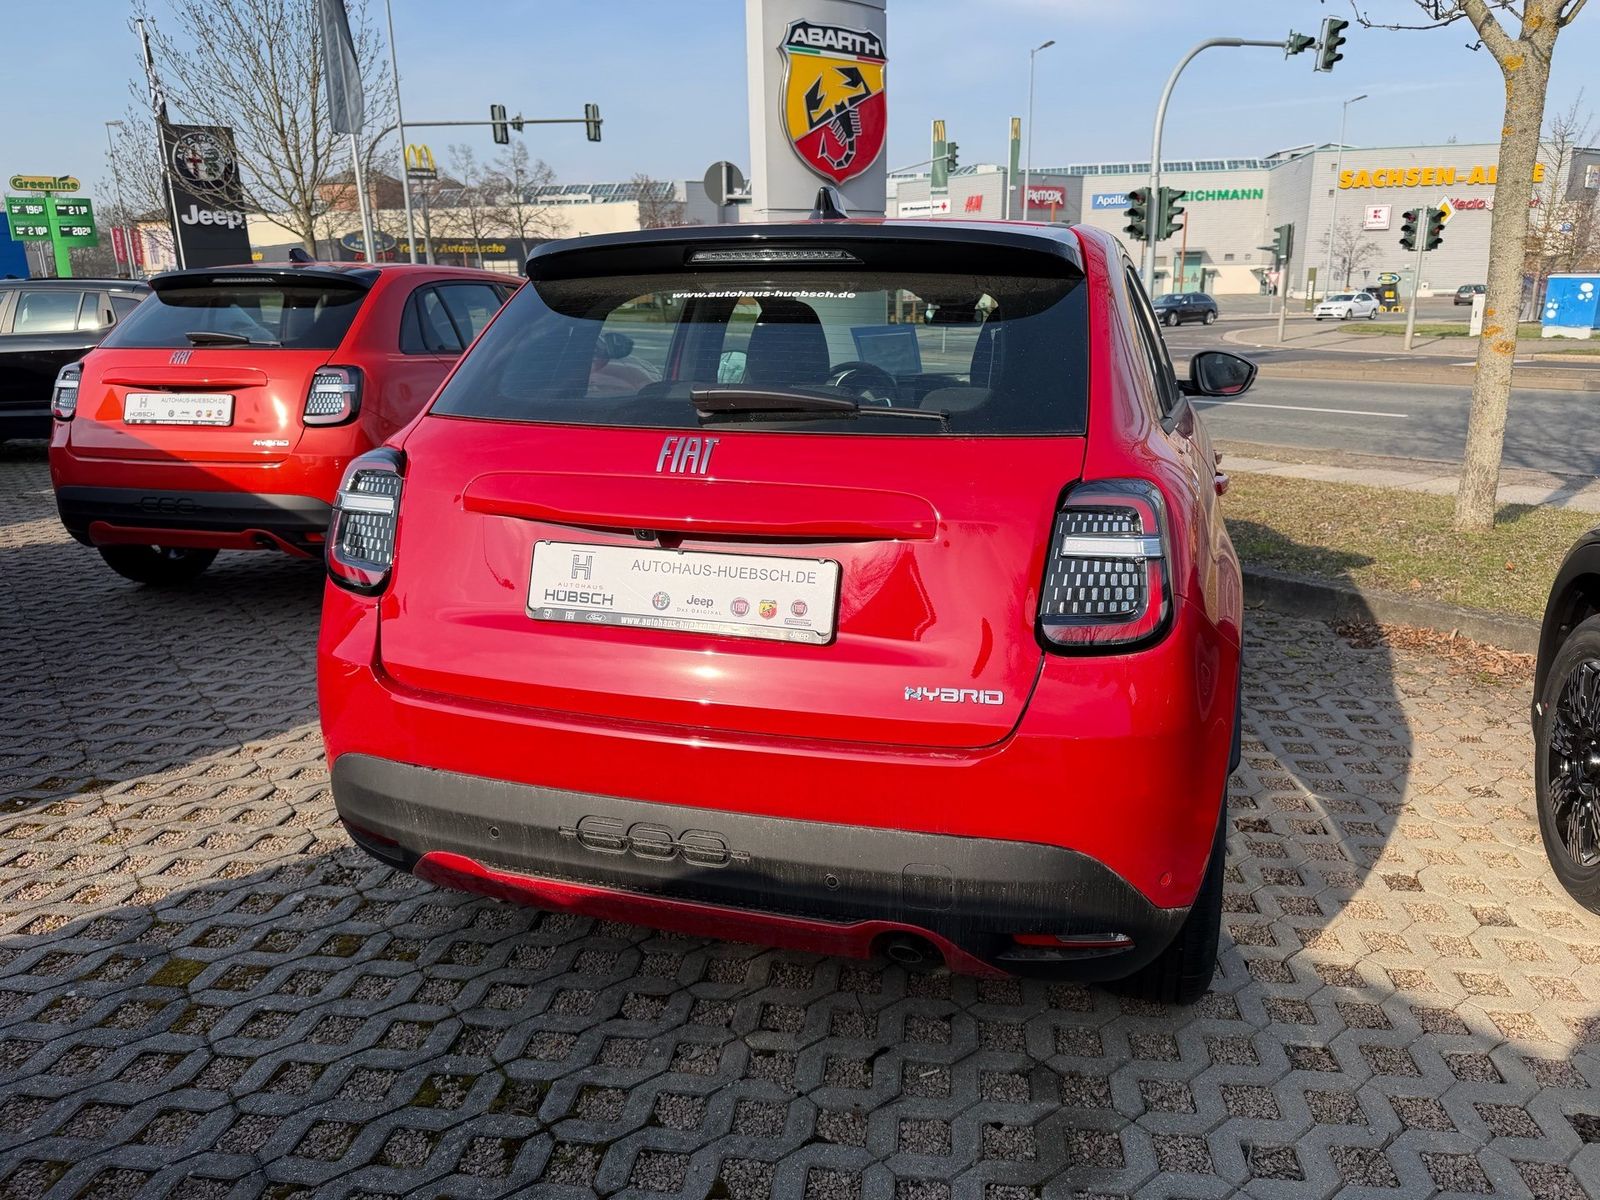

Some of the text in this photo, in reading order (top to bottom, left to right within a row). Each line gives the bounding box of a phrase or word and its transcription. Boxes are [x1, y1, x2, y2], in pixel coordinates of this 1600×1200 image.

[790, 28, 879, 55] ABARTH
[12, 176, 78, 190] Greenline
[1338, 163, 1545, 189] SACHSEN-ALE
[1181, 189, 1263, 202] EICHMANN
[181, 204, 242, 229] Jeep
[672, 290, 856, 299] www.autohaus-huebsch.de
[169, 350, 194, 364] FIAT
[656, 436, 720, 475] FIAT
[631, 559, 817, 585] AUTOHAUS-HUEBSCH.DE
[557, 582, 605, 590] AUTOHAUS
[544, 588, 614, 606] HÜBSCH
[686, 595, 714, 608] Jeep
[904, 686, 1004, 705] HYBRID
[575, 814, 732, 869] 600
